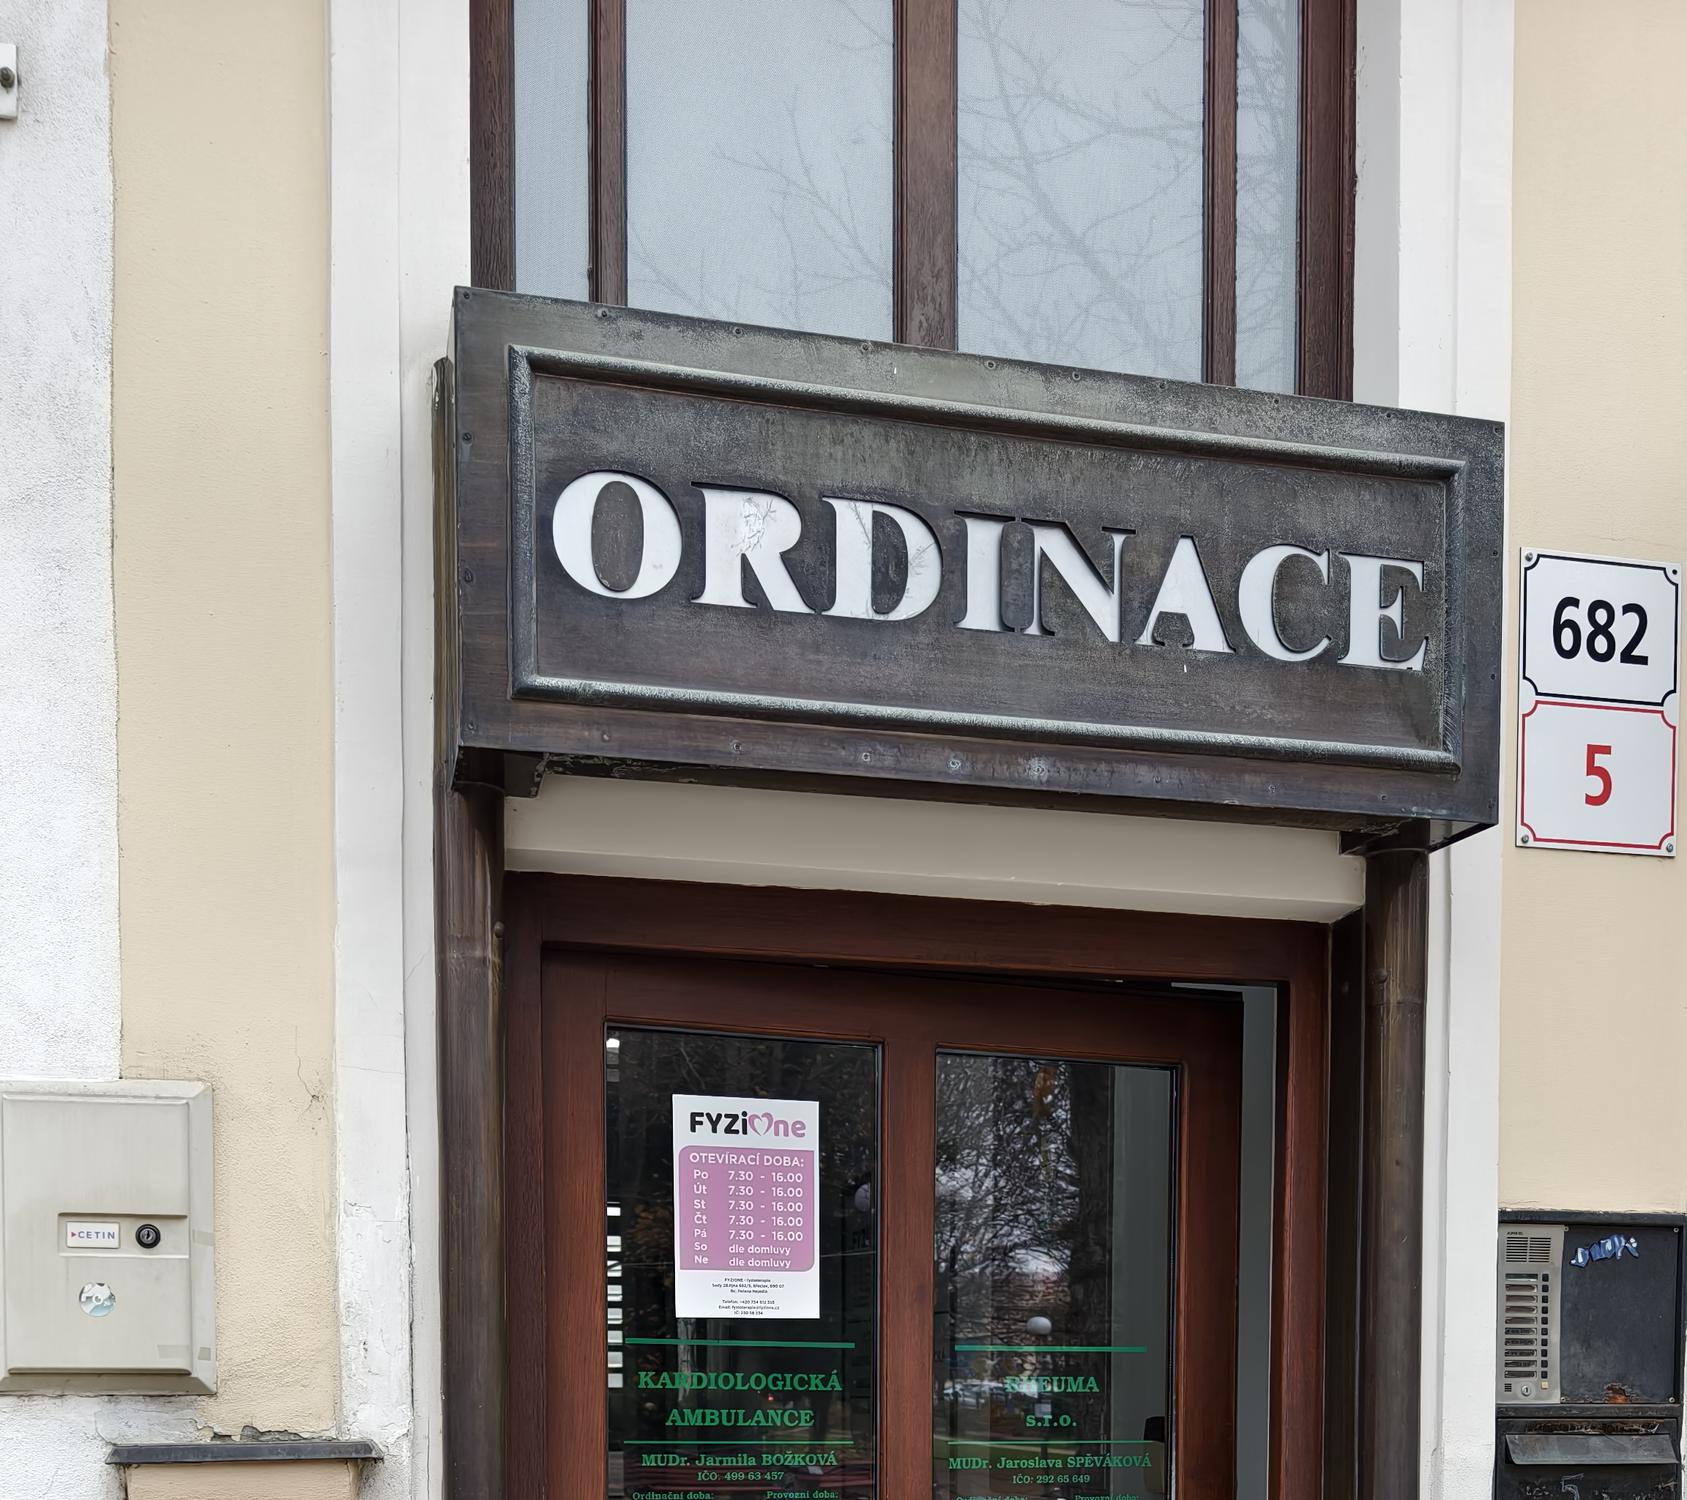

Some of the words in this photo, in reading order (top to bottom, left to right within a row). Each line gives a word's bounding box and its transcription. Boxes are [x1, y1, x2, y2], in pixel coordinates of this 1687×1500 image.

[552, 469, 1429, 671] ORDINACE
[1552, 596, 1649, 666] 682
[1584, 743, 1612, 806] 5
[689, 1152, 760, 1166] OTEVÍRACÍ
[764, 1155, 804, 1167] DOBA:
[694, 1170, 708, 1179] Po
[728, 1171, 753, 1181] 7.30
[772, 1172, 803, 1182] 16.00
[694, 1183, 707, 1194] Út
[728, 1186, 753, 1196] 7.30
[772, 1187, 803, 1197] 16.00
[694, 1199, 706, 1209] St
[728, 1201, 753, 1211] 7.30
[772, 1202, 803, 1212] 16.00
[694, 1212, 707, 1224] Čt
[728, 1215, 753, 1225] 7.30
[772, 1217, 803, 1227] 16.00
[78, 1230, 115, 1240] CETIN
[694, 1228, 707, 1238] Pá
[728, 1230, 753, 1240] 7.30
[772, 1232, 803, 1241] 16.00
[694, 1242, 707, 1250] So
[729, 1244, 744, 1253] dle
[748, 1245, 791, 1256] domluvy
[694, 1255, 708, 1264] Ne
[729, 1257, 744, 1266] dle
[748, 1258, 791, 1269] domluvy
[638, 1370, 842, 1391] KARDIOLOGICKÁ
[1005, 1376, 1100, 1393] RHEUMA
[665, 1409, 815, 1426] AMBULANCE
[1025, 1415, 1077, 1427] s.r.o.
[641, 1454, 690, 1466] MUDr.
[695, 1453, 756, 1466] Jarmila
[761, 1451, 838, 1466] BOŽKOVÁ
[948, 1457, 992, 1469] MUDr.
[997, 1457, 1062, 1469] Jaroslava
[1067, 1452, 1152, 1467] SPĚVÁKOVÁ
[697, 1470, 720, 1481] IČO:
[724, 1472, 745, 1481] 499
[748, 1472, 761, 1481] 63
[764, 1471, 784, 1481] 457
[1013, 1474, 1034, 1484] IČO:
[1036, 1475, 1054, 1483] 292
[1057, 1475, 1069, 1483] 65
[1072, 1474, 1090, 1483] 649
[632, 1491, 684, 1500] Ordinační
[686, 1491, 714, 1500] doba:
[767, 1490, 810, 1499] Provozní
[812, 1490, 839, 1499] doba:
